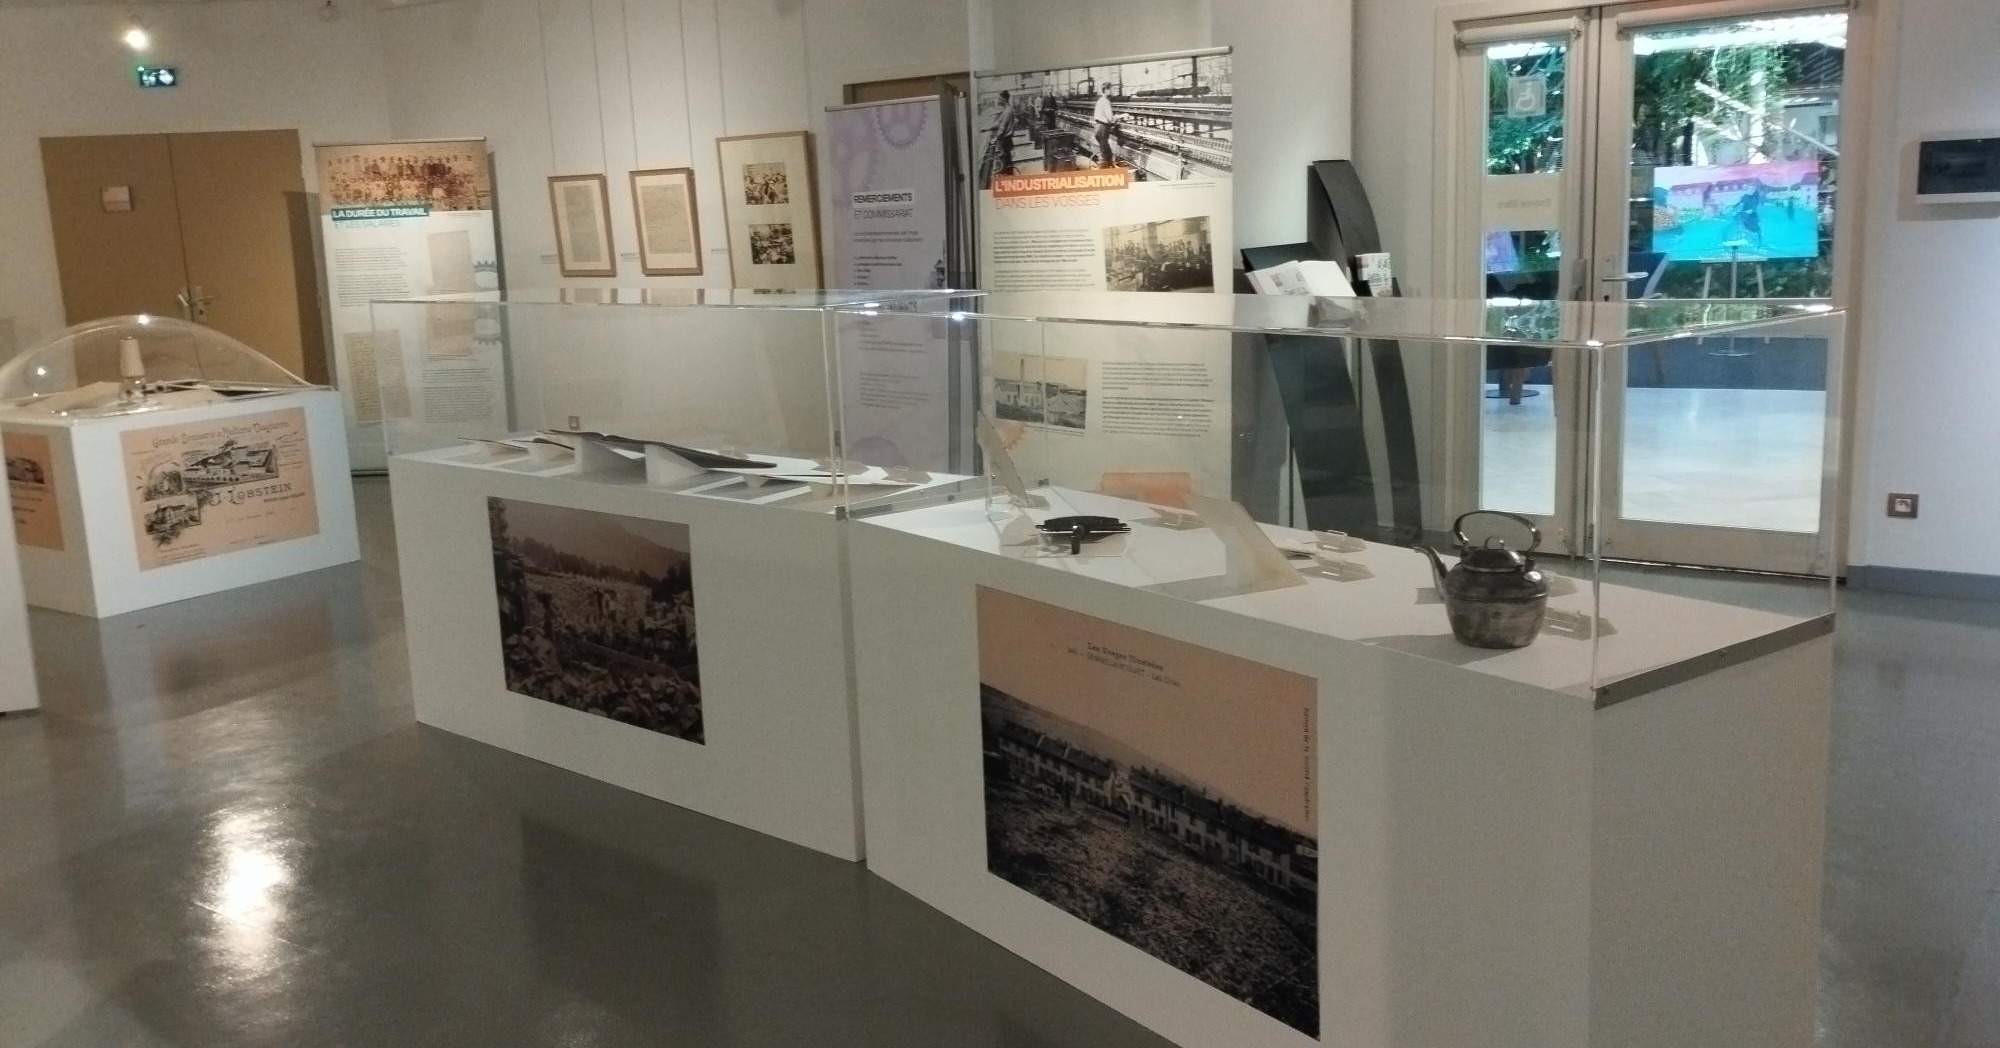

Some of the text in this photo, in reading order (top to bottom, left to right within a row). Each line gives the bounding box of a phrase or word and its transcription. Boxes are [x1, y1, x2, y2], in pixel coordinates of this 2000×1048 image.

[995, 174, 1125, 192] L'INDUSTRIALISATION
[854, 193, 912, 203] REMERCIEMENTS
[996, 195, 1100, 209] DANS LES VOSGES
[332, 207, 428, 218] LA DURÉE DU TRAVAIL
